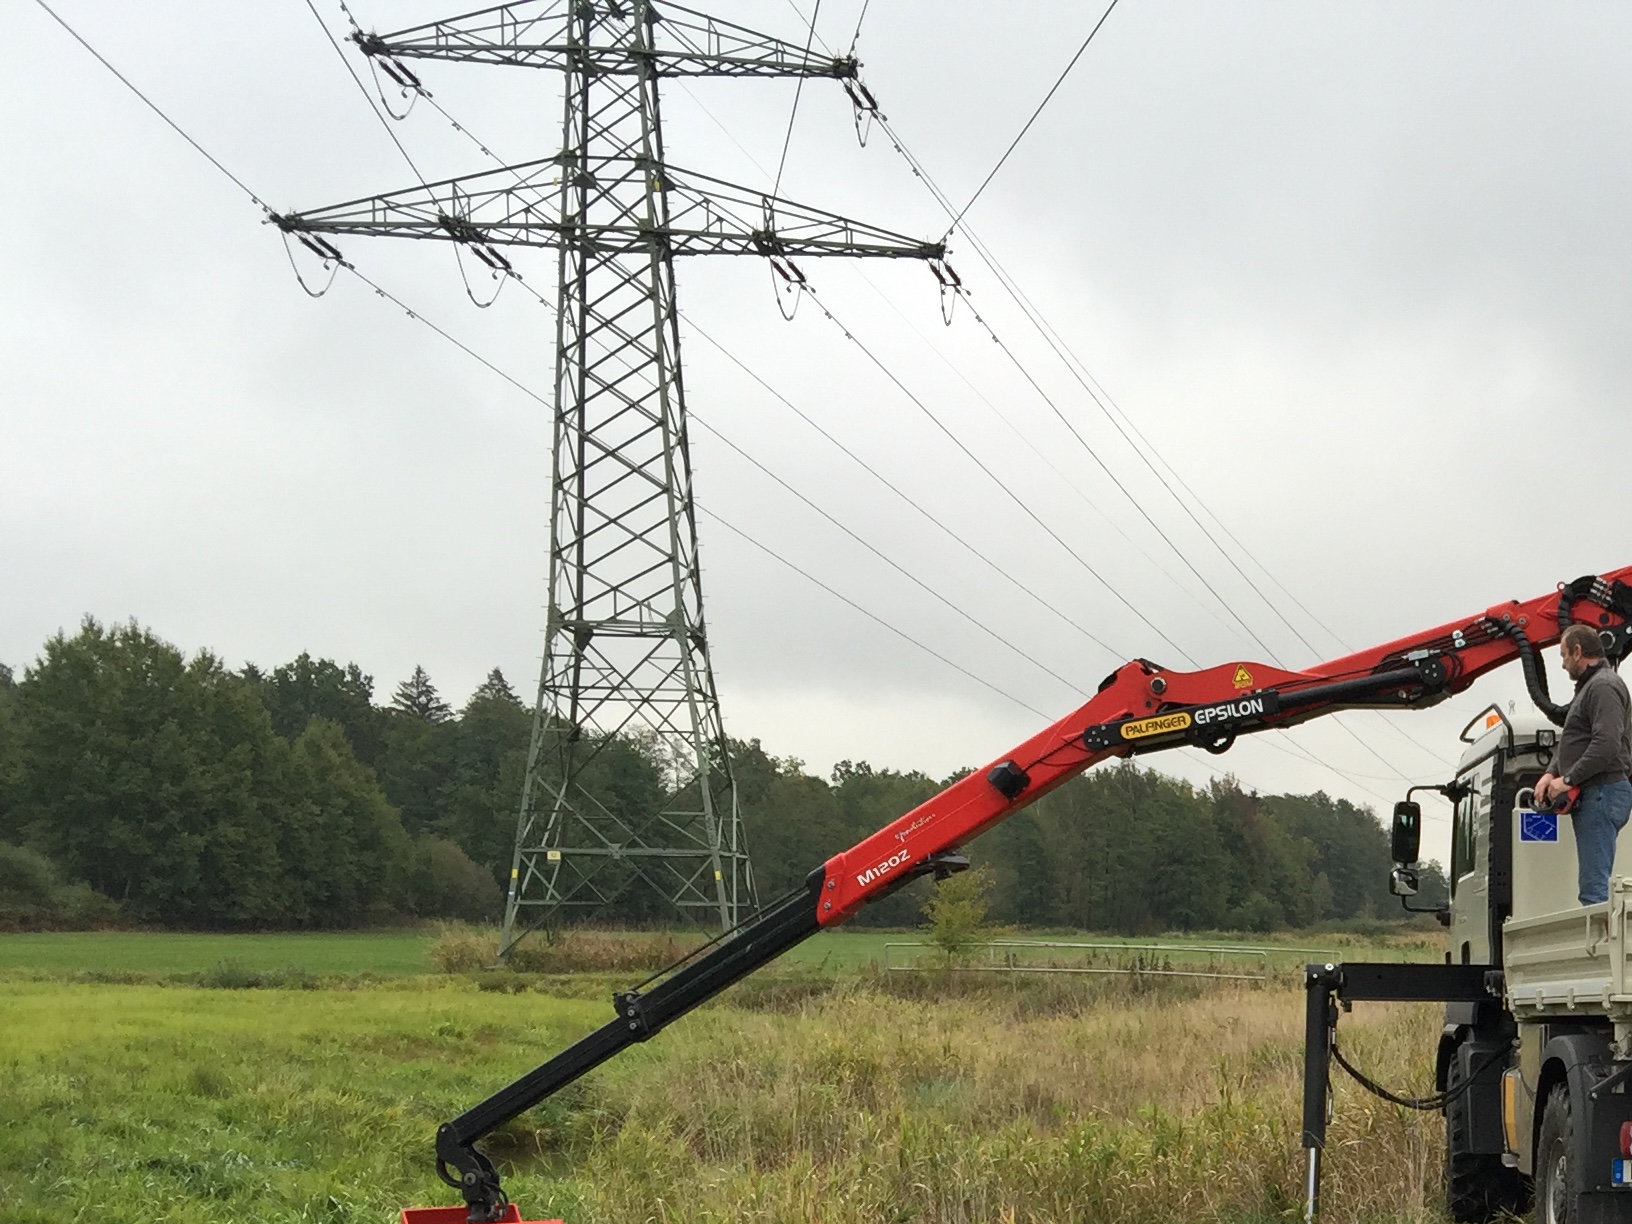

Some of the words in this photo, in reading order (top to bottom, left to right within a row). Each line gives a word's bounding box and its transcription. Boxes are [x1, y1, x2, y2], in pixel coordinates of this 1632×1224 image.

[1125, 715, 1187, 737] PALFINGER
[1194, 698, 1264, 725] EPSILON
[856, 848, 911, 887] M120Z
